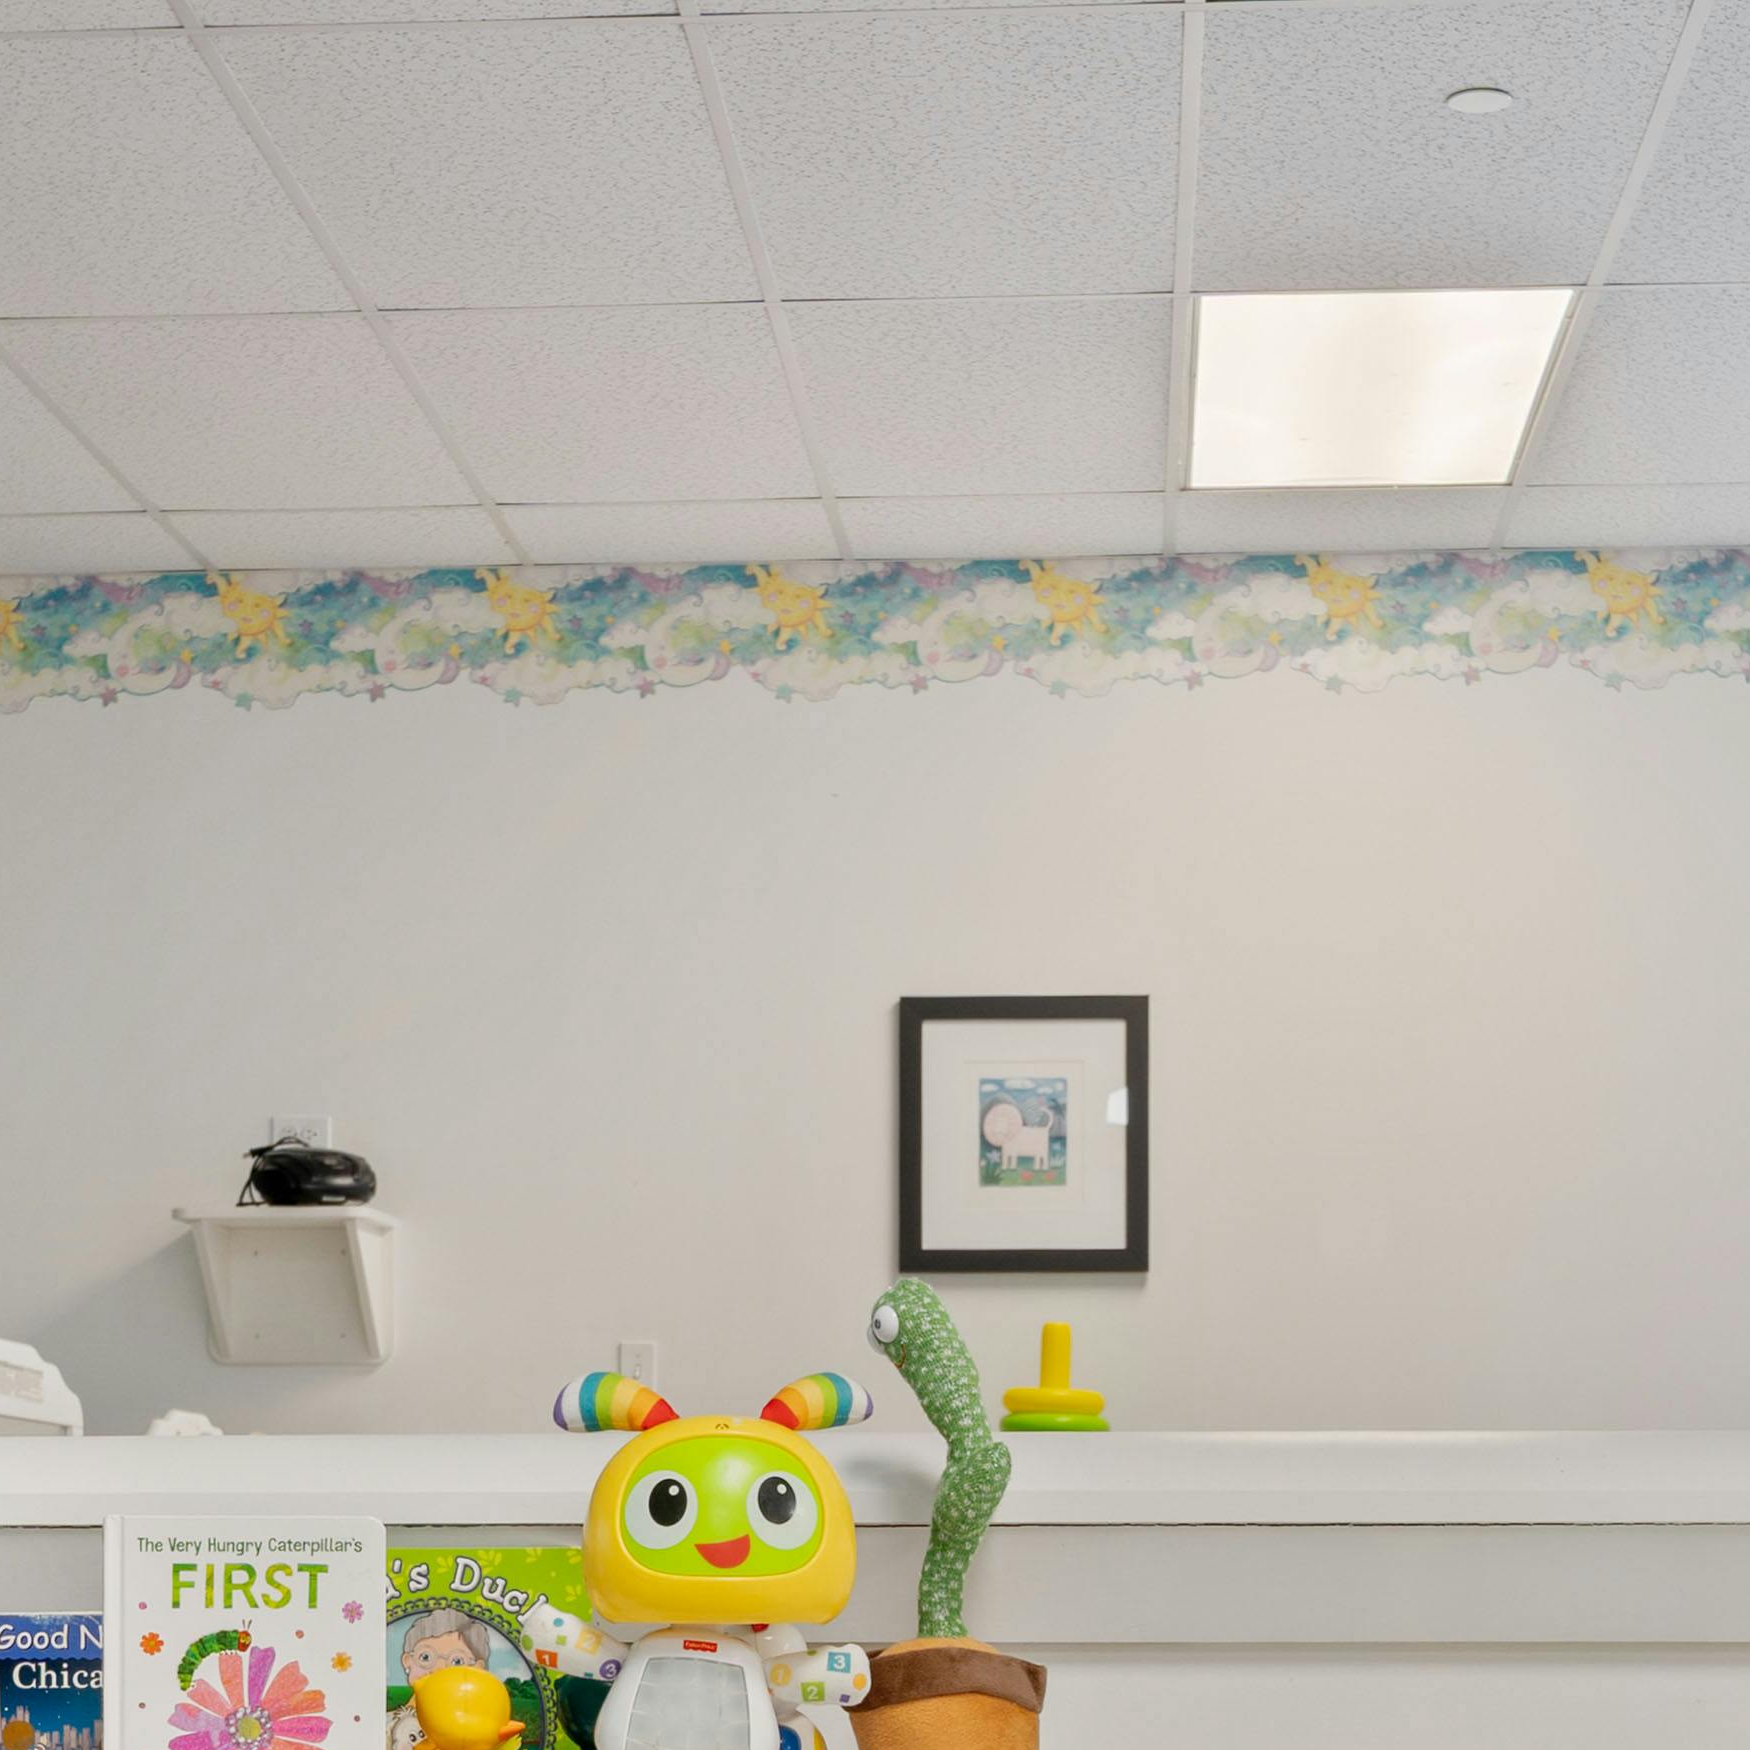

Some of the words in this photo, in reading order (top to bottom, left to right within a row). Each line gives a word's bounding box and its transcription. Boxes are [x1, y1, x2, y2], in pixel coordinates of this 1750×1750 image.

[137, 1537, 164, 1553] The
[168, 1537, 202, 1556] Very
[207, 1537, 263, 1556] Hungry
[267, 1537, 363, 1556] Caterpillar's
[171, 1562, 329, 1610] FIRST
[542, 1653, 551, 1666] 1
[833, 1654, 846, 1670] 3
[604, 1663, 618, 1678] 3
[806, 1685, 819, 1701] 2
